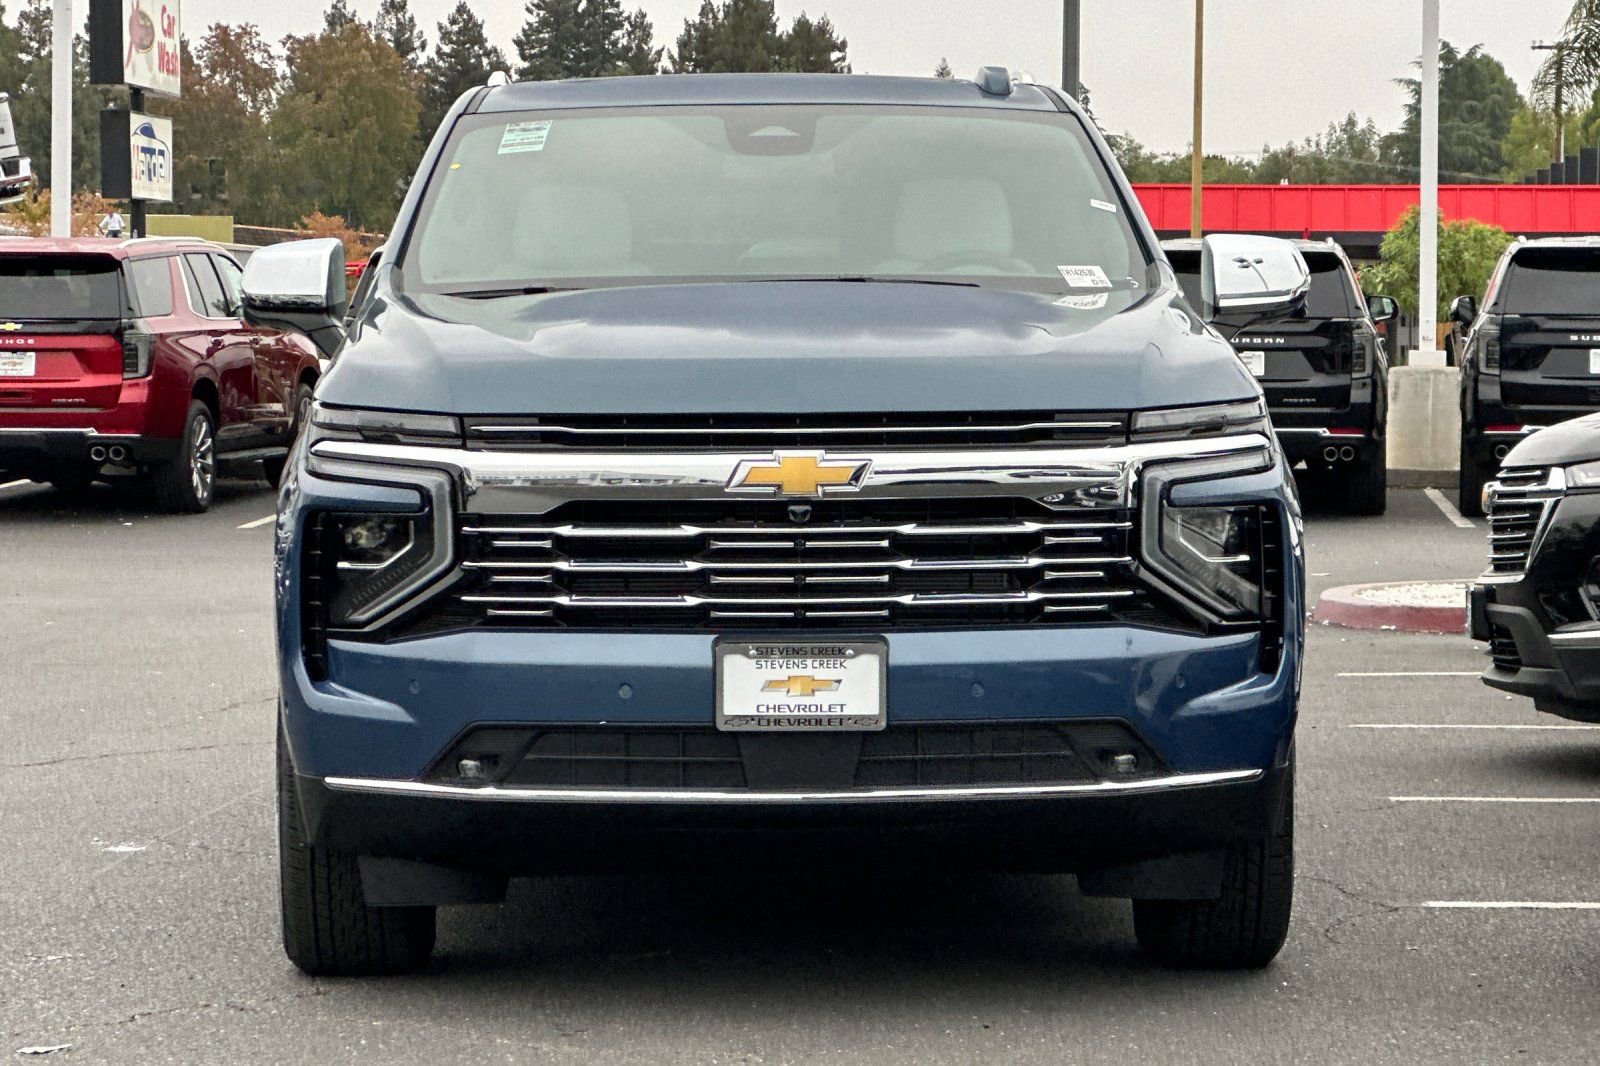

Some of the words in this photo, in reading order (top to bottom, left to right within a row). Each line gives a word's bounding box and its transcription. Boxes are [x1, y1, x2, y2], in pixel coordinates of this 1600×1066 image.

[160, 4, 176, 40] Car
[157, 41, 179, 78] Wash
[756, 646, 808, 656] STEVENS
[811, 646, 846, 656] CREEK
[755, 659, 808, 669] STEVENS
[811, 659, 847, 669] CREEK
[756, 703, 847, 713] CHEVROLET
[757, 717, 845, 727] CHEVROLET
